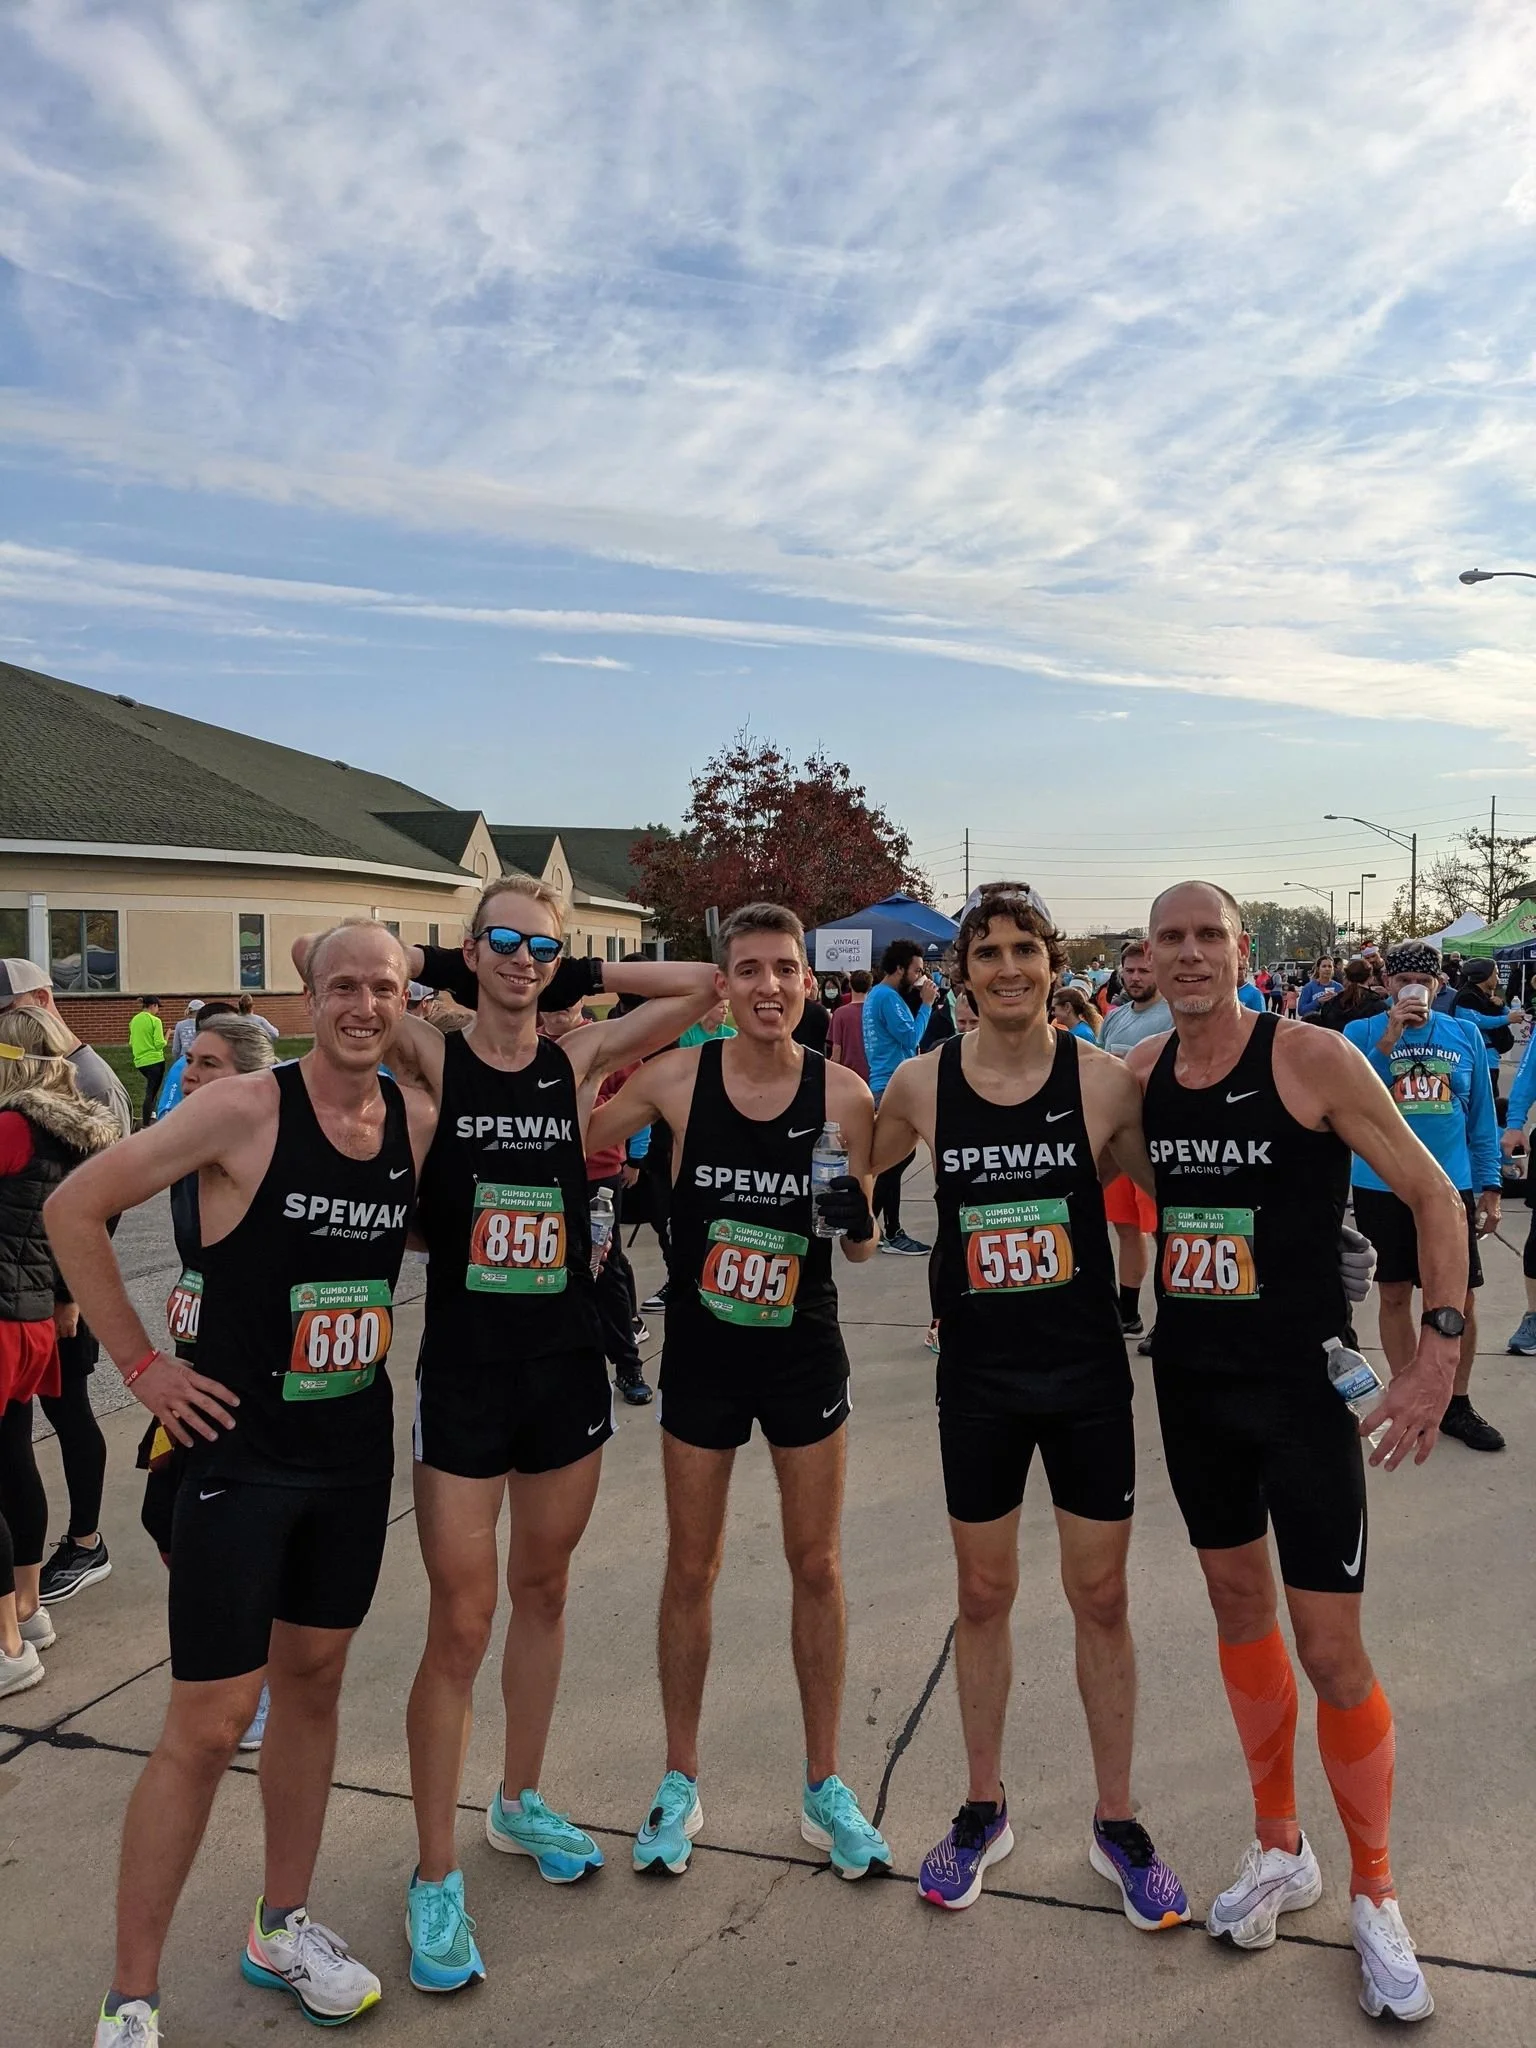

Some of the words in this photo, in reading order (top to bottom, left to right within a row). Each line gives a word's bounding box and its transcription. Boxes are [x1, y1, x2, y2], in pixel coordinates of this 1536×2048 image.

[1390, 1047, 1433, 1059] UMPKIN
[1437, 1049, 1461, 1063] RUN
[1403, 1075, 1441, 1099] 197
[456, 1116, 572, 1141] SPEWAK
[502, 1141, 542, 1150] RACING
[1150, 1139, 1272, 1164] SPEWAK
[943, 1143, 1077, 1173] SPEWAK
[990, 1170, 1032, 1181] RACING
[1184, 1165, 1221, 1175] RACING
[502, 1190, 531, 1199] GUMBO
[532, 1191, 553, 1199] FLATS
[737, 1194, 778, 1205] RACING
[283, 1192, 407, 1228] SPEWAK
[500, 1198, 535, 1206] PUMPKIN
[537, 1200, 553, 1208] RUN
[985, 1208, 1015, 1217] GUMBO
[1017, 1205, 1039, 1214] FLATS
[986, 1215, 1021, 1225] PUMPKIN
[1023, 1213, 1040, 1221] RUN
[1178, 1221, 1208, 1229] PUMPKIN
[330, 1227, 368, 1240] RACING
[486, 1214, 559, 1264] 856
[736, 1226, 763, 1238] GUMBO
[765, 1232, 785, 1242] FLATS
[733, 1234, 767, 1247] PUMPKIN
[768, 1241, 784, 1250] RUN
[979, 1229, 1059, 1284] 553
[1171, 1238, 1239, 1290] 226
[716, 1248, 791, 1302] 695
[320, 1286, 348, 1295] GUMBO
[349, 1285, 369, 1294] FLATS
[320, 1296, 352, 1304] PUMPKIN
[354, 1295, 369, 1303] RUN
[169, 1291, 201, 1336] 750
[308, 1312, 379, 1368] 680
